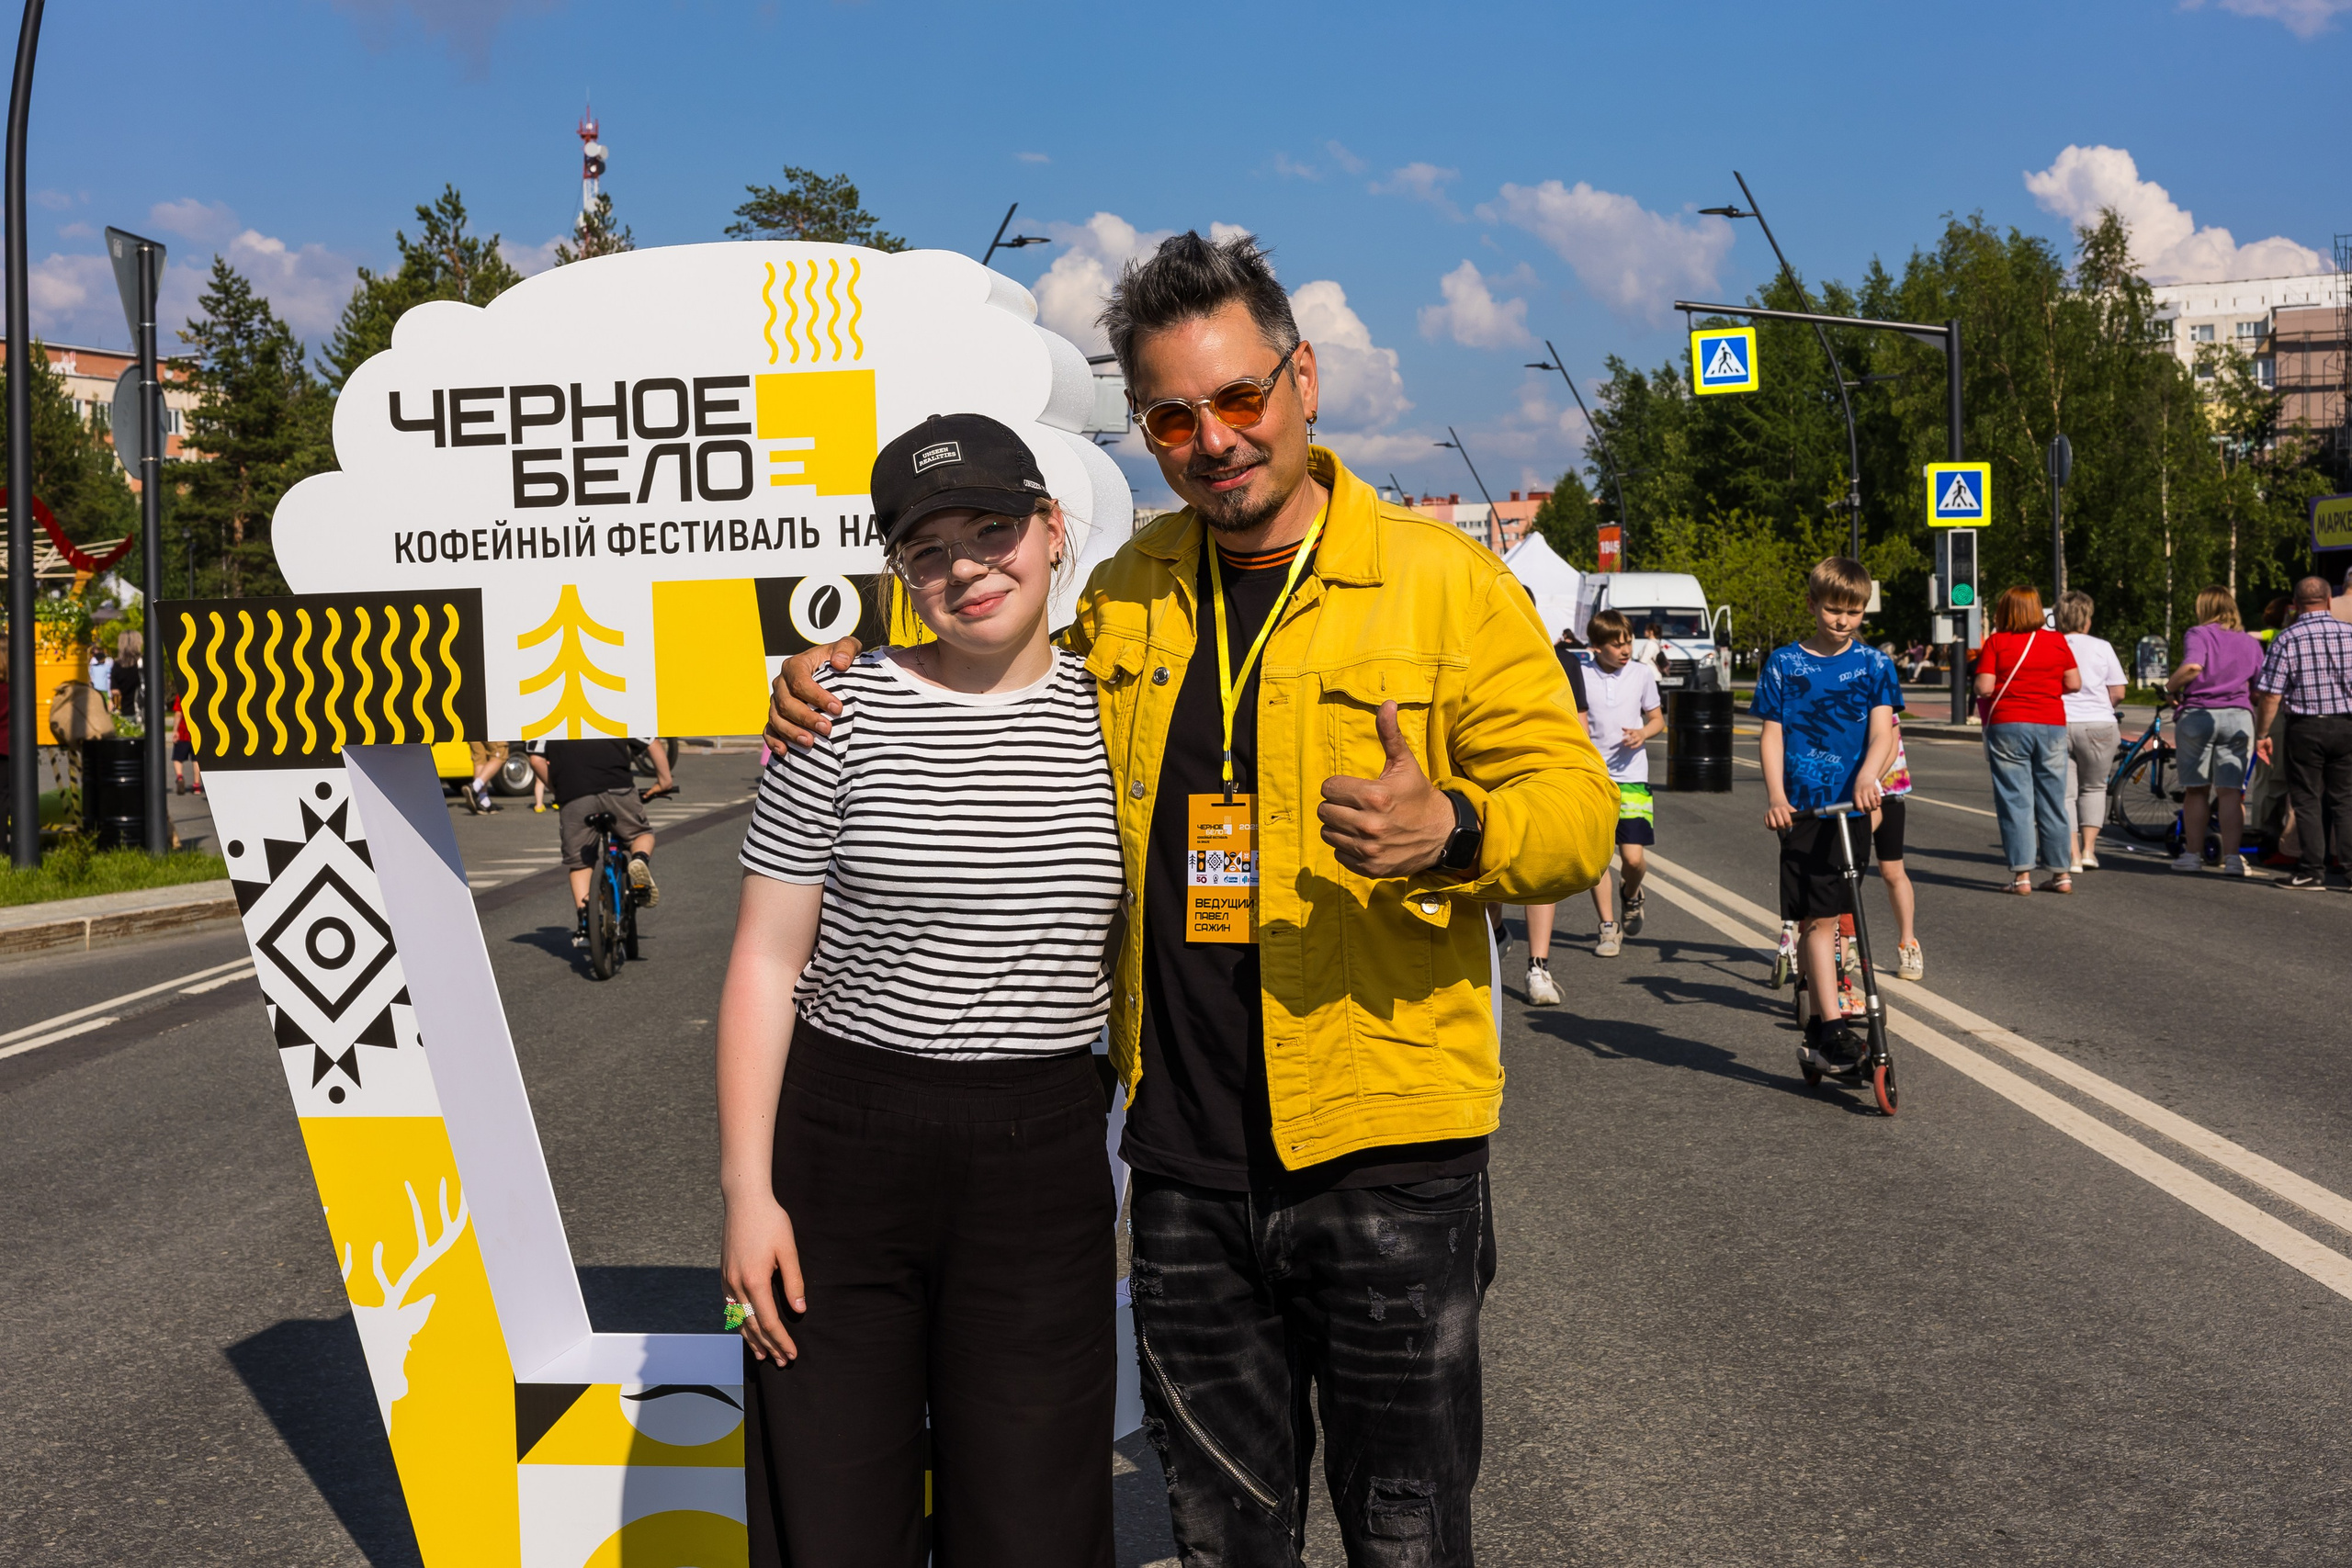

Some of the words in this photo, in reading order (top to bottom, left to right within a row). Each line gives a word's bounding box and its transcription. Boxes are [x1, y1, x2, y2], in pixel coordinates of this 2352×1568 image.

[389, 374, 752, 448] ЧЕРНОЕ
[922, 446, 949, 458] UNSEEN
[919, 452, 956, 467] REALITIES
[394, 514, 597, 564] КОФЕЙНЫЙ
[607, 516, 820, 558] ФЕСТИВАЛЬ
[840, 513, 885, 547] НА
[1195, 897, 1254, 910] ВЕДУЩИЙ
[1194, 911, 1228, 920] ПАВЕЛ
[1194, 923, 1231, 932] САЖИН
